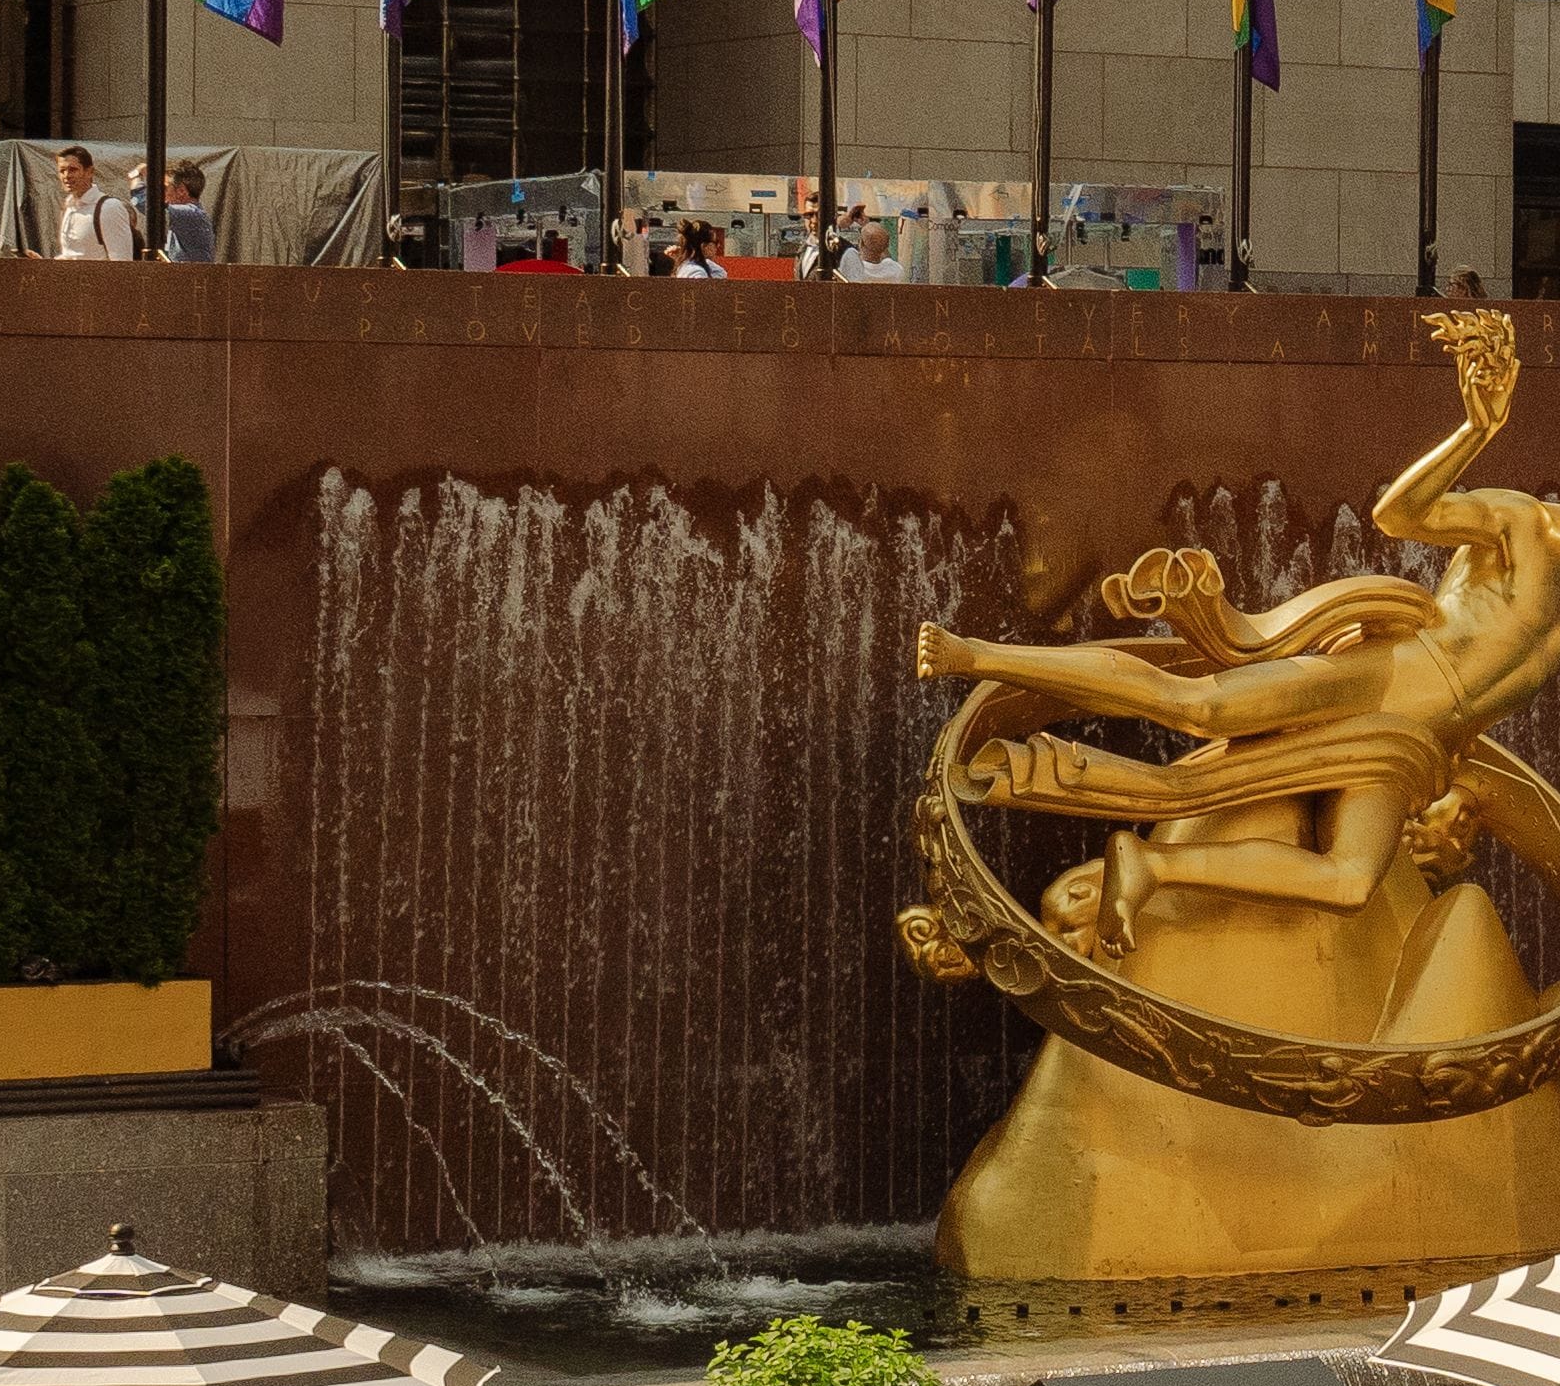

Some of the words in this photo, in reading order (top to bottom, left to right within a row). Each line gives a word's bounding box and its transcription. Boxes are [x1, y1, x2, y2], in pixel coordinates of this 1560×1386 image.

[890, 298, 950, 319] IN
[1035, 301, 1240, 325] EVERY
[359, 320, 641, 346] PROVED
[732, 327, 800, 349] TO
